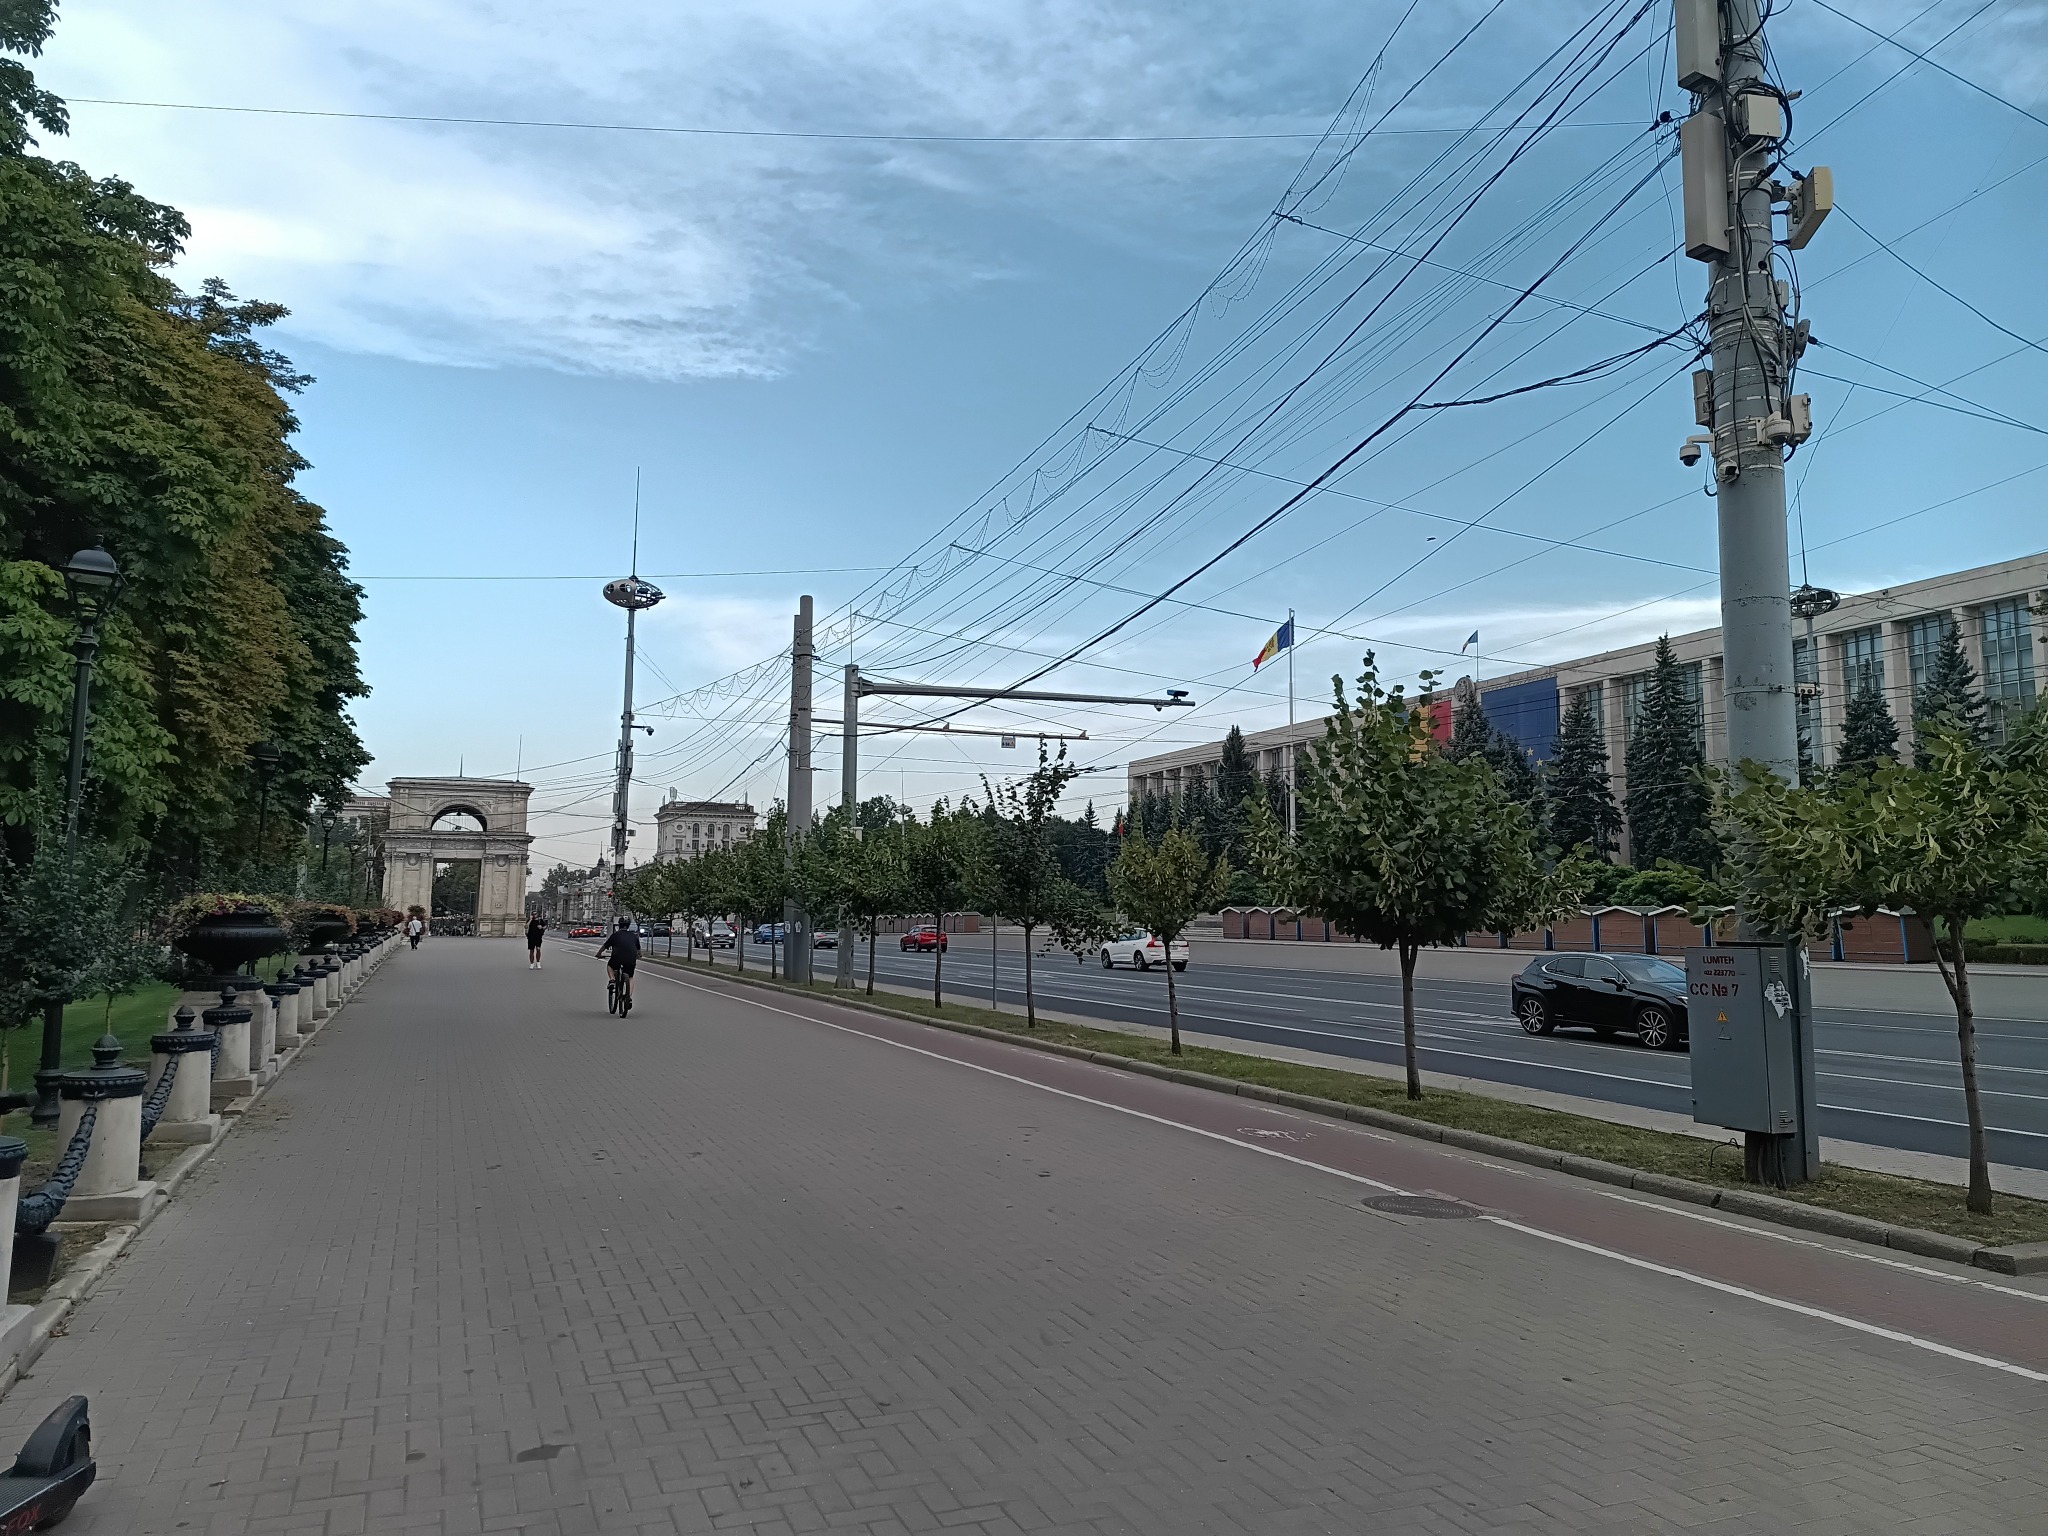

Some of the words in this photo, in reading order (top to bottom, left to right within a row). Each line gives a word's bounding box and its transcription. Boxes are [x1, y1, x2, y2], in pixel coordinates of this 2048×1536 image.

[1702, 955, 1735, 965] LUMTEH
[1713, 969, 1736, 977] 223770
[1731, 983, 1739, 997] 7
